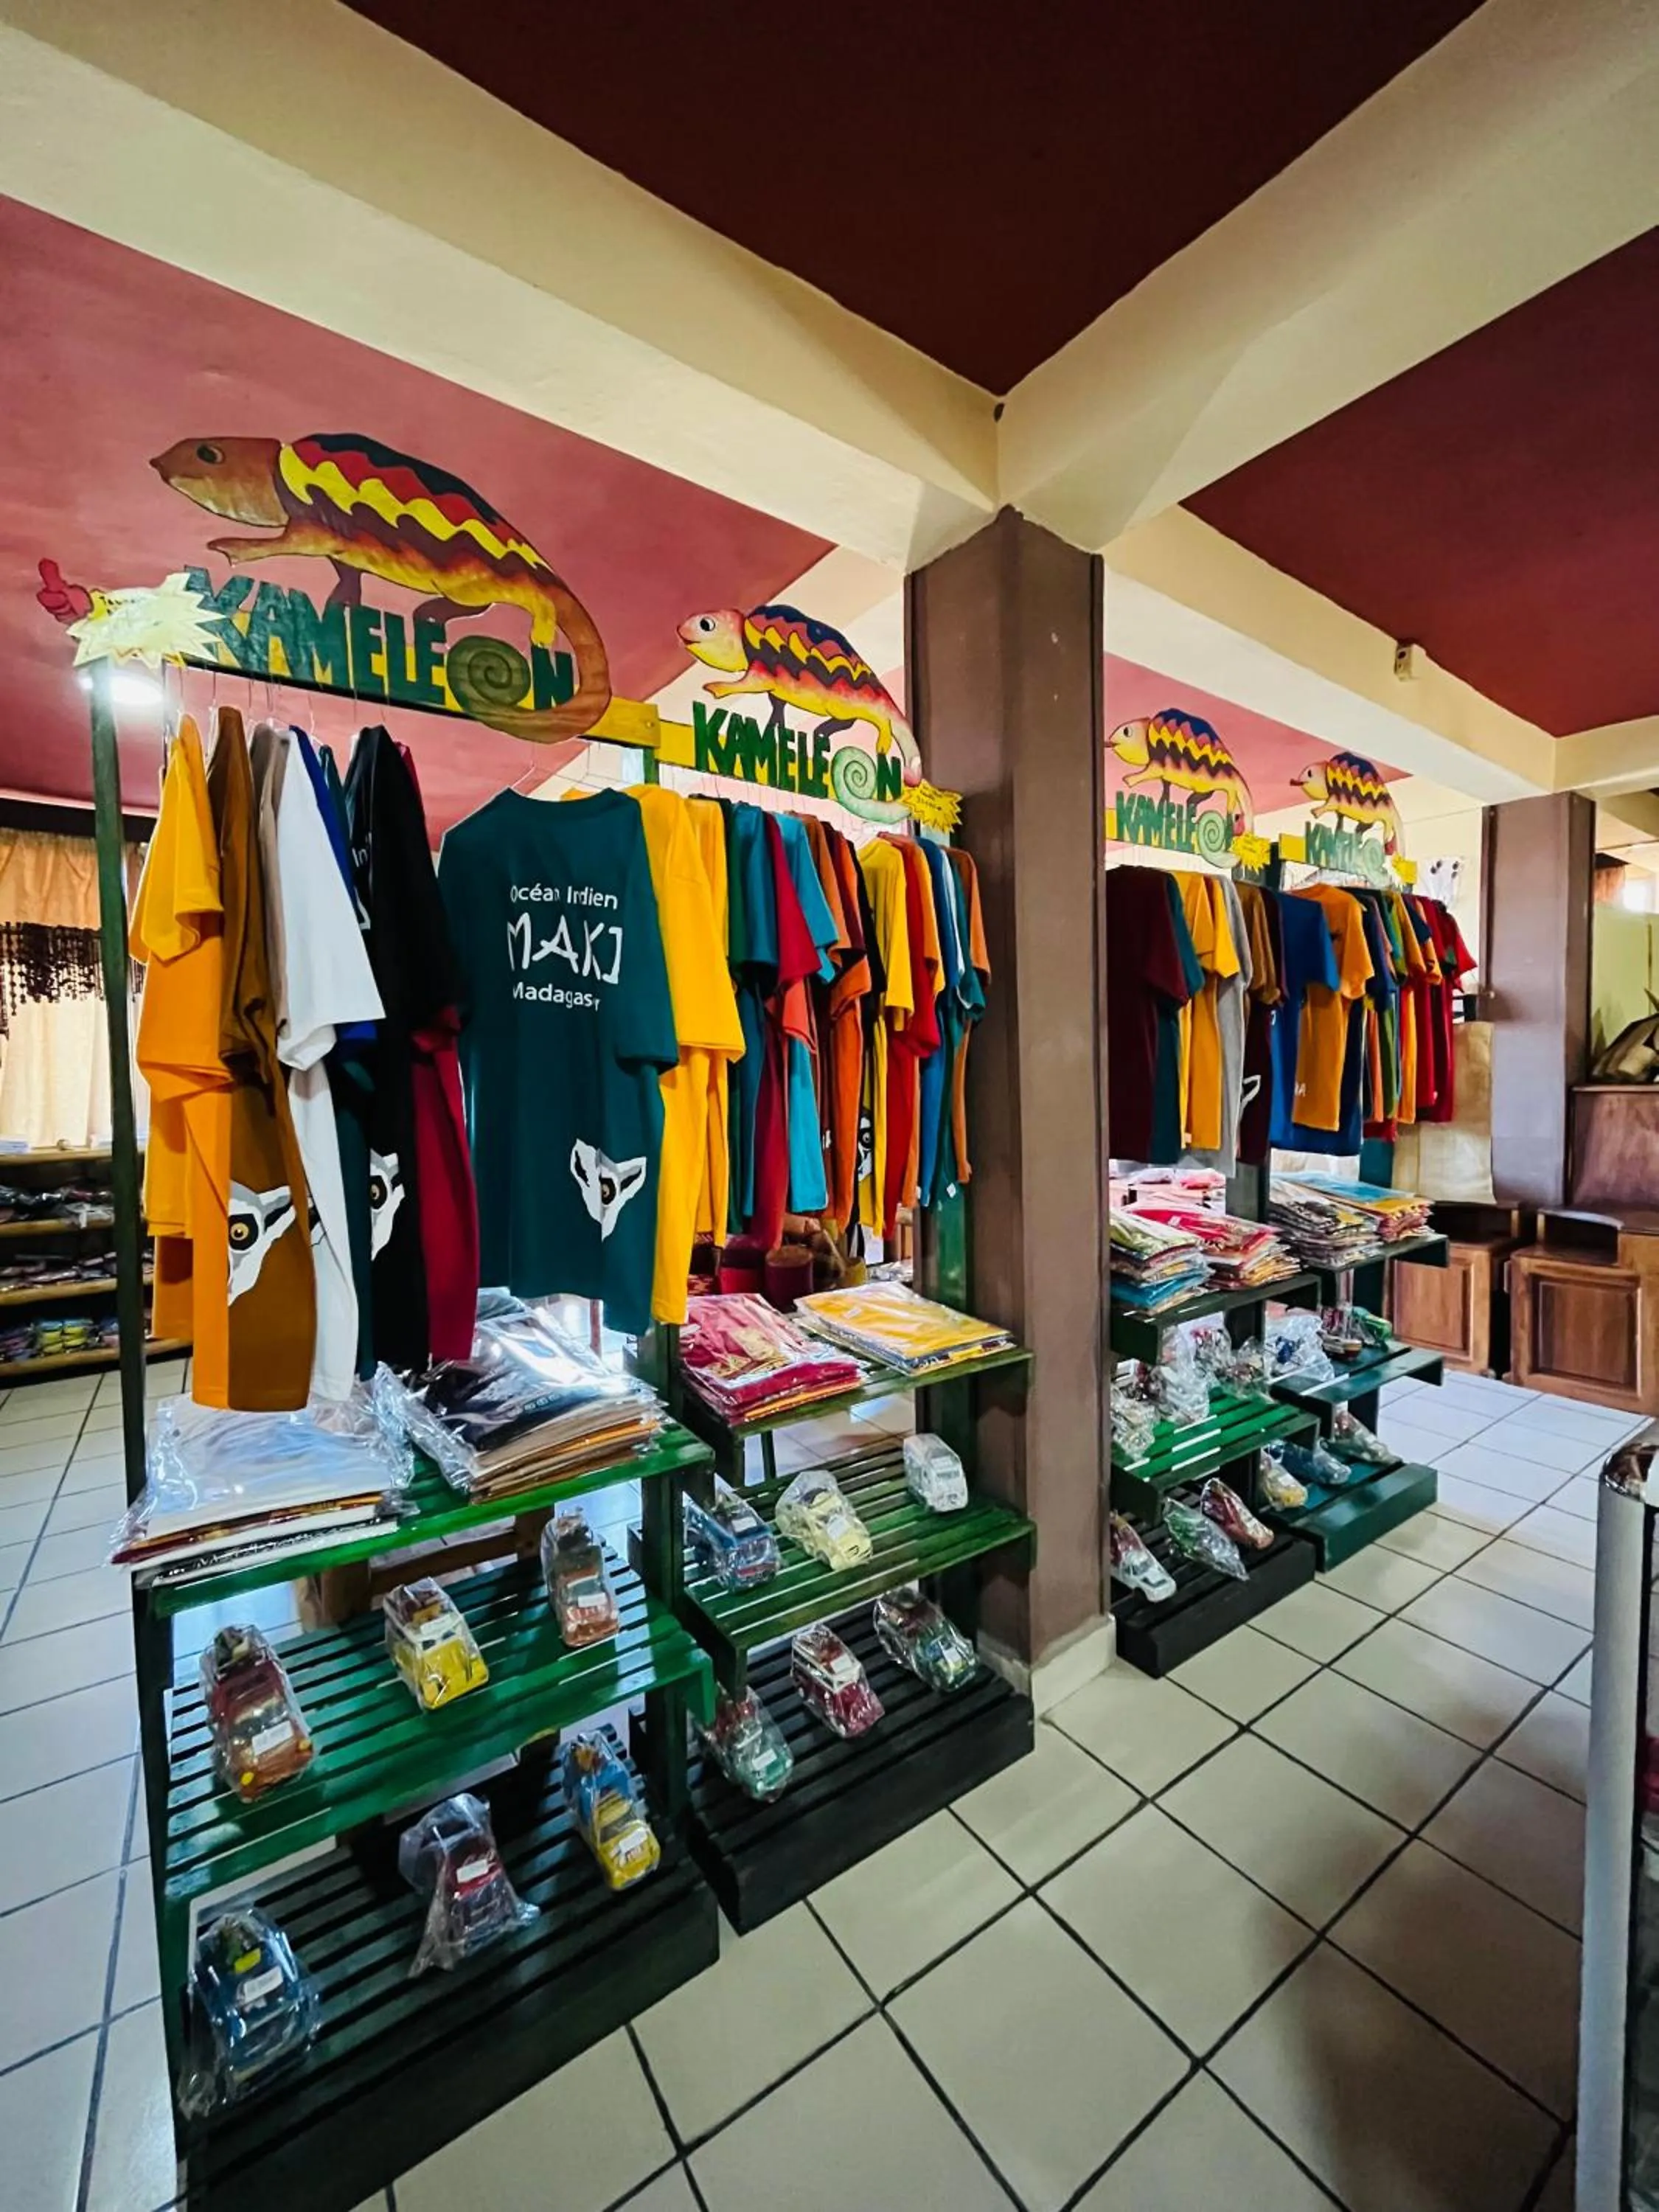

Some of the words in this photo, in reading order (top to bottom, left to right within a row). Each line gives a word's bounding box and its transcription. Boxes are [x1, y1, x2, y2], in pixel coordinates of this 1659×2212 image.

[184, 564, 574, 713] KAMELEON
[692, 700, 902, 802] KAMELEON
[507, 912, 623, 984] MAKI
